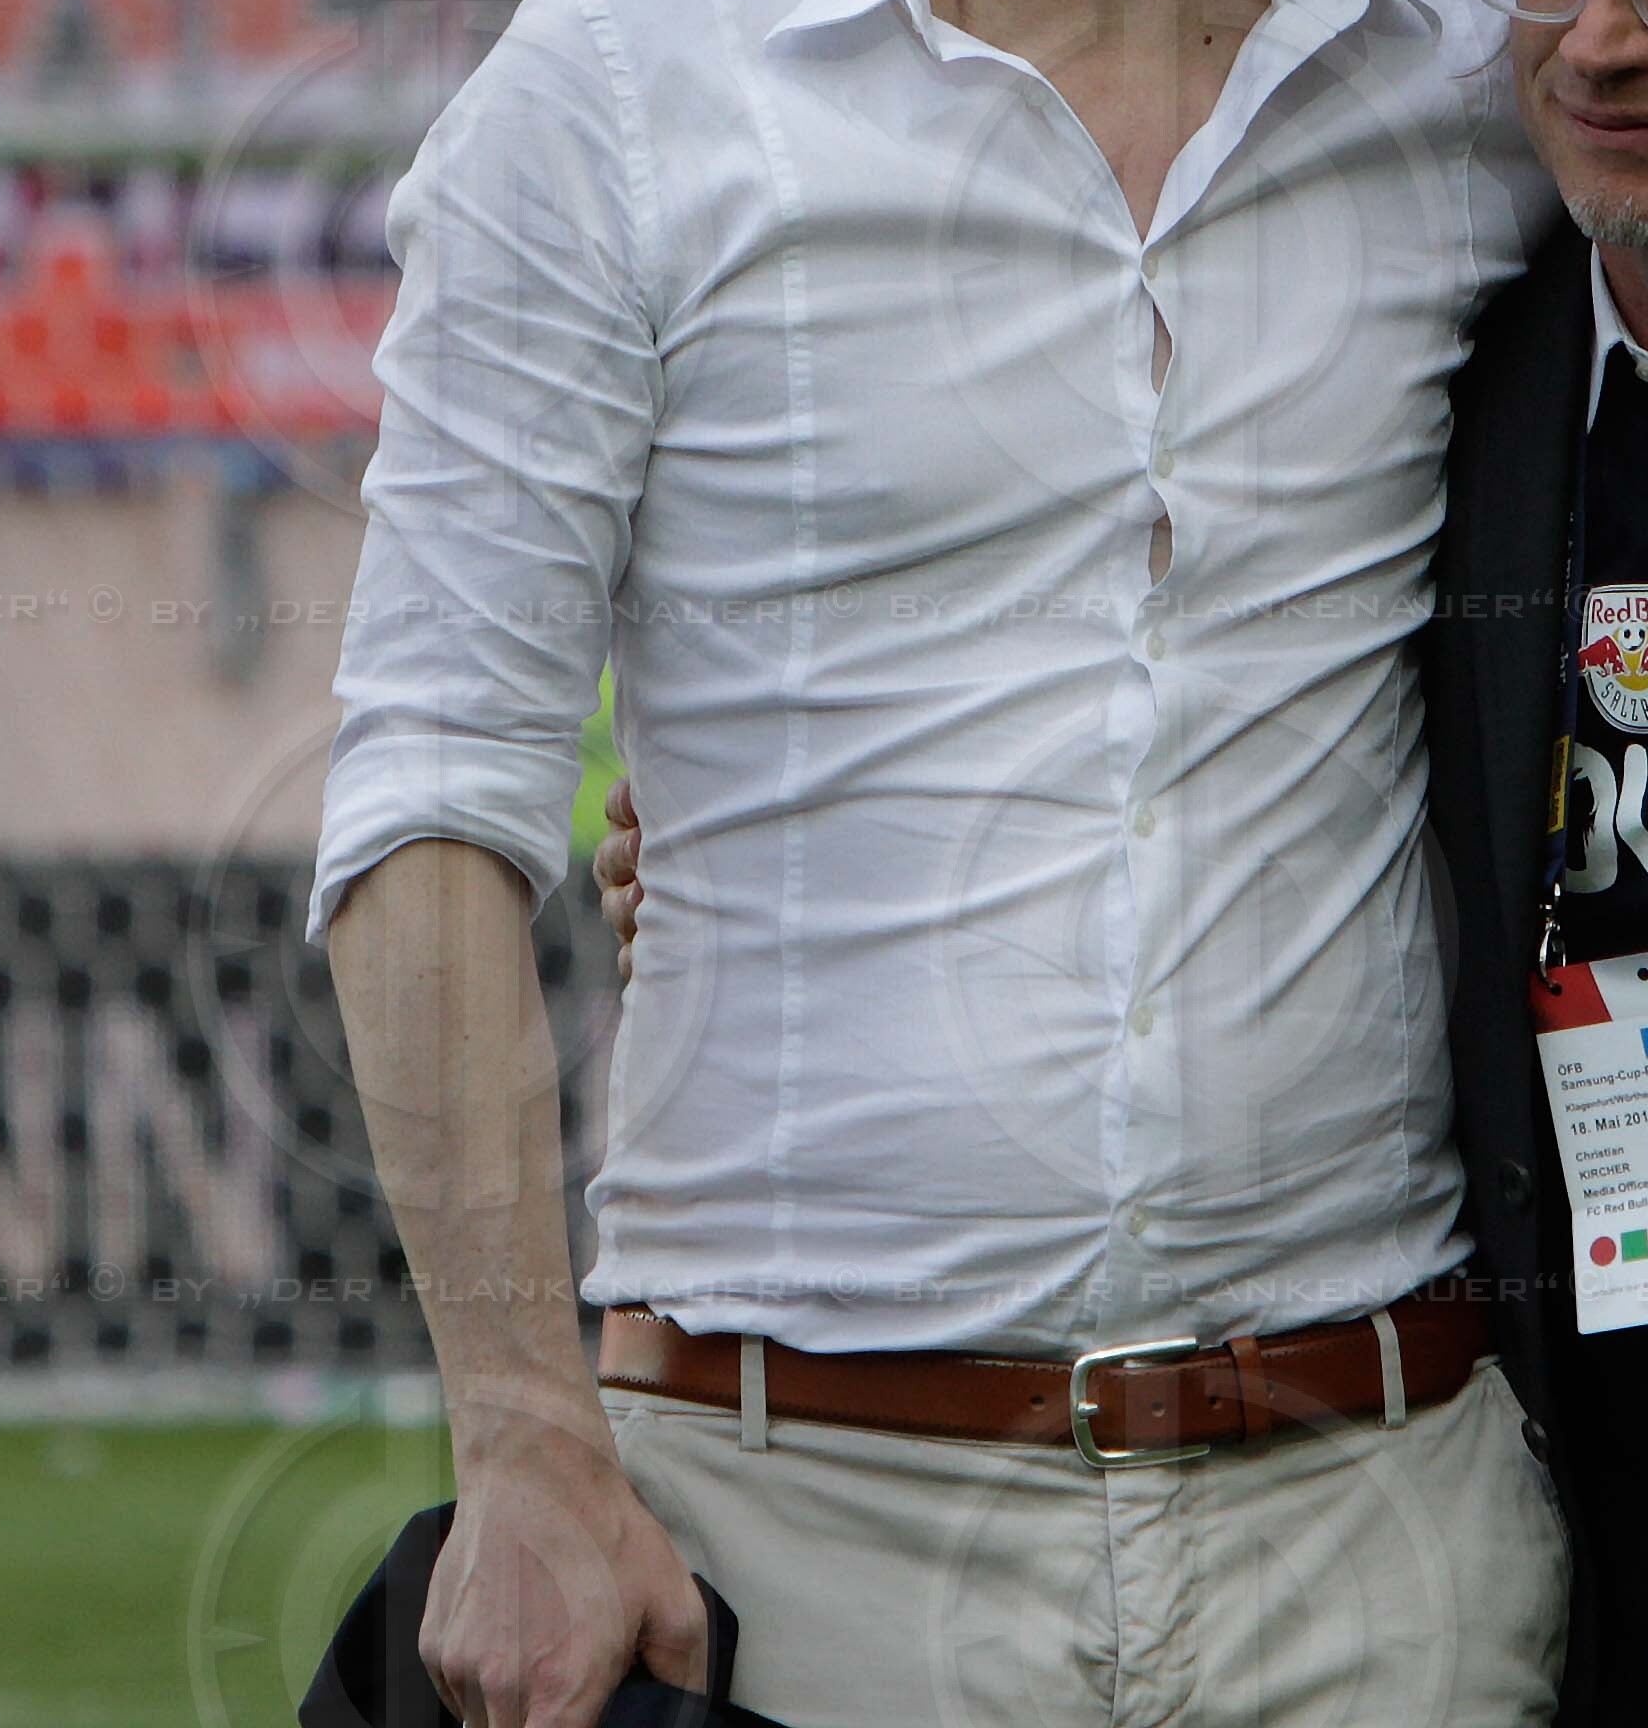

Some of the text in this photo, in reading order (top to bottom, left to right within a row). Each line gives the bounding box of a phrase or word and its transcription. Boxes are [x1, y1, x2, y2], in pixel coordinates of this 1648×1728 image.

[1571, 1121, 1592, 1136] 18.
[1595, 1114, 1621, 1132] Mai
[1575, 1146, 1625, 1163] Christian
[1579, 1162, 1631, 1181] KIRCHER
[1583, 1185, 1615, 1200] Media
[1586, 1206, 1602, 1217] FC
[1604, 1202, 1625, 1214] Red
[1627, 1197, 1648, 1211] Bull
